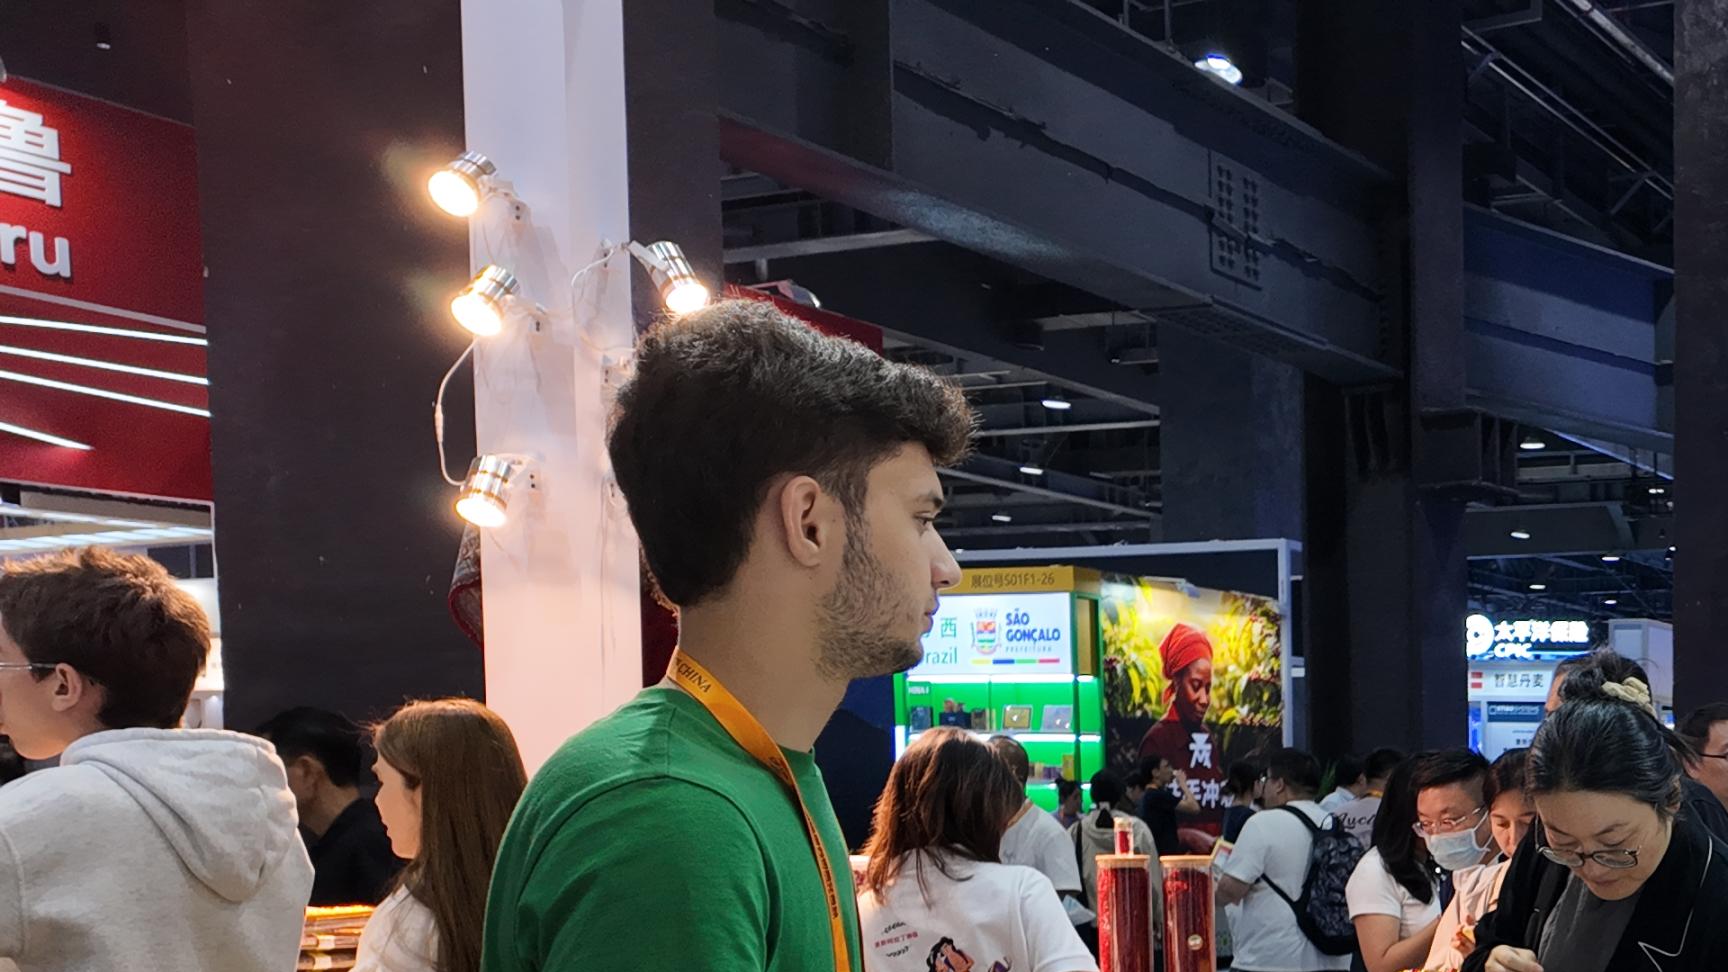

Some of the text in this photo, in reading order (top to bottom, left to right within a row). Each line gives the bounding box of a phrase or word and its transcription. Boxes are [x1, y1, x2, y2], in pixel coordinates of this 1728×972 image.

[1005, 608, 1030, 626] SÃO
[1005, 628, 1061, 645] GONÇALO
[925, 646, 958, 665] razil
[679, 662, 712, 693] CHINA
[1494, 673, 1544, 688] 智慧丹麦
